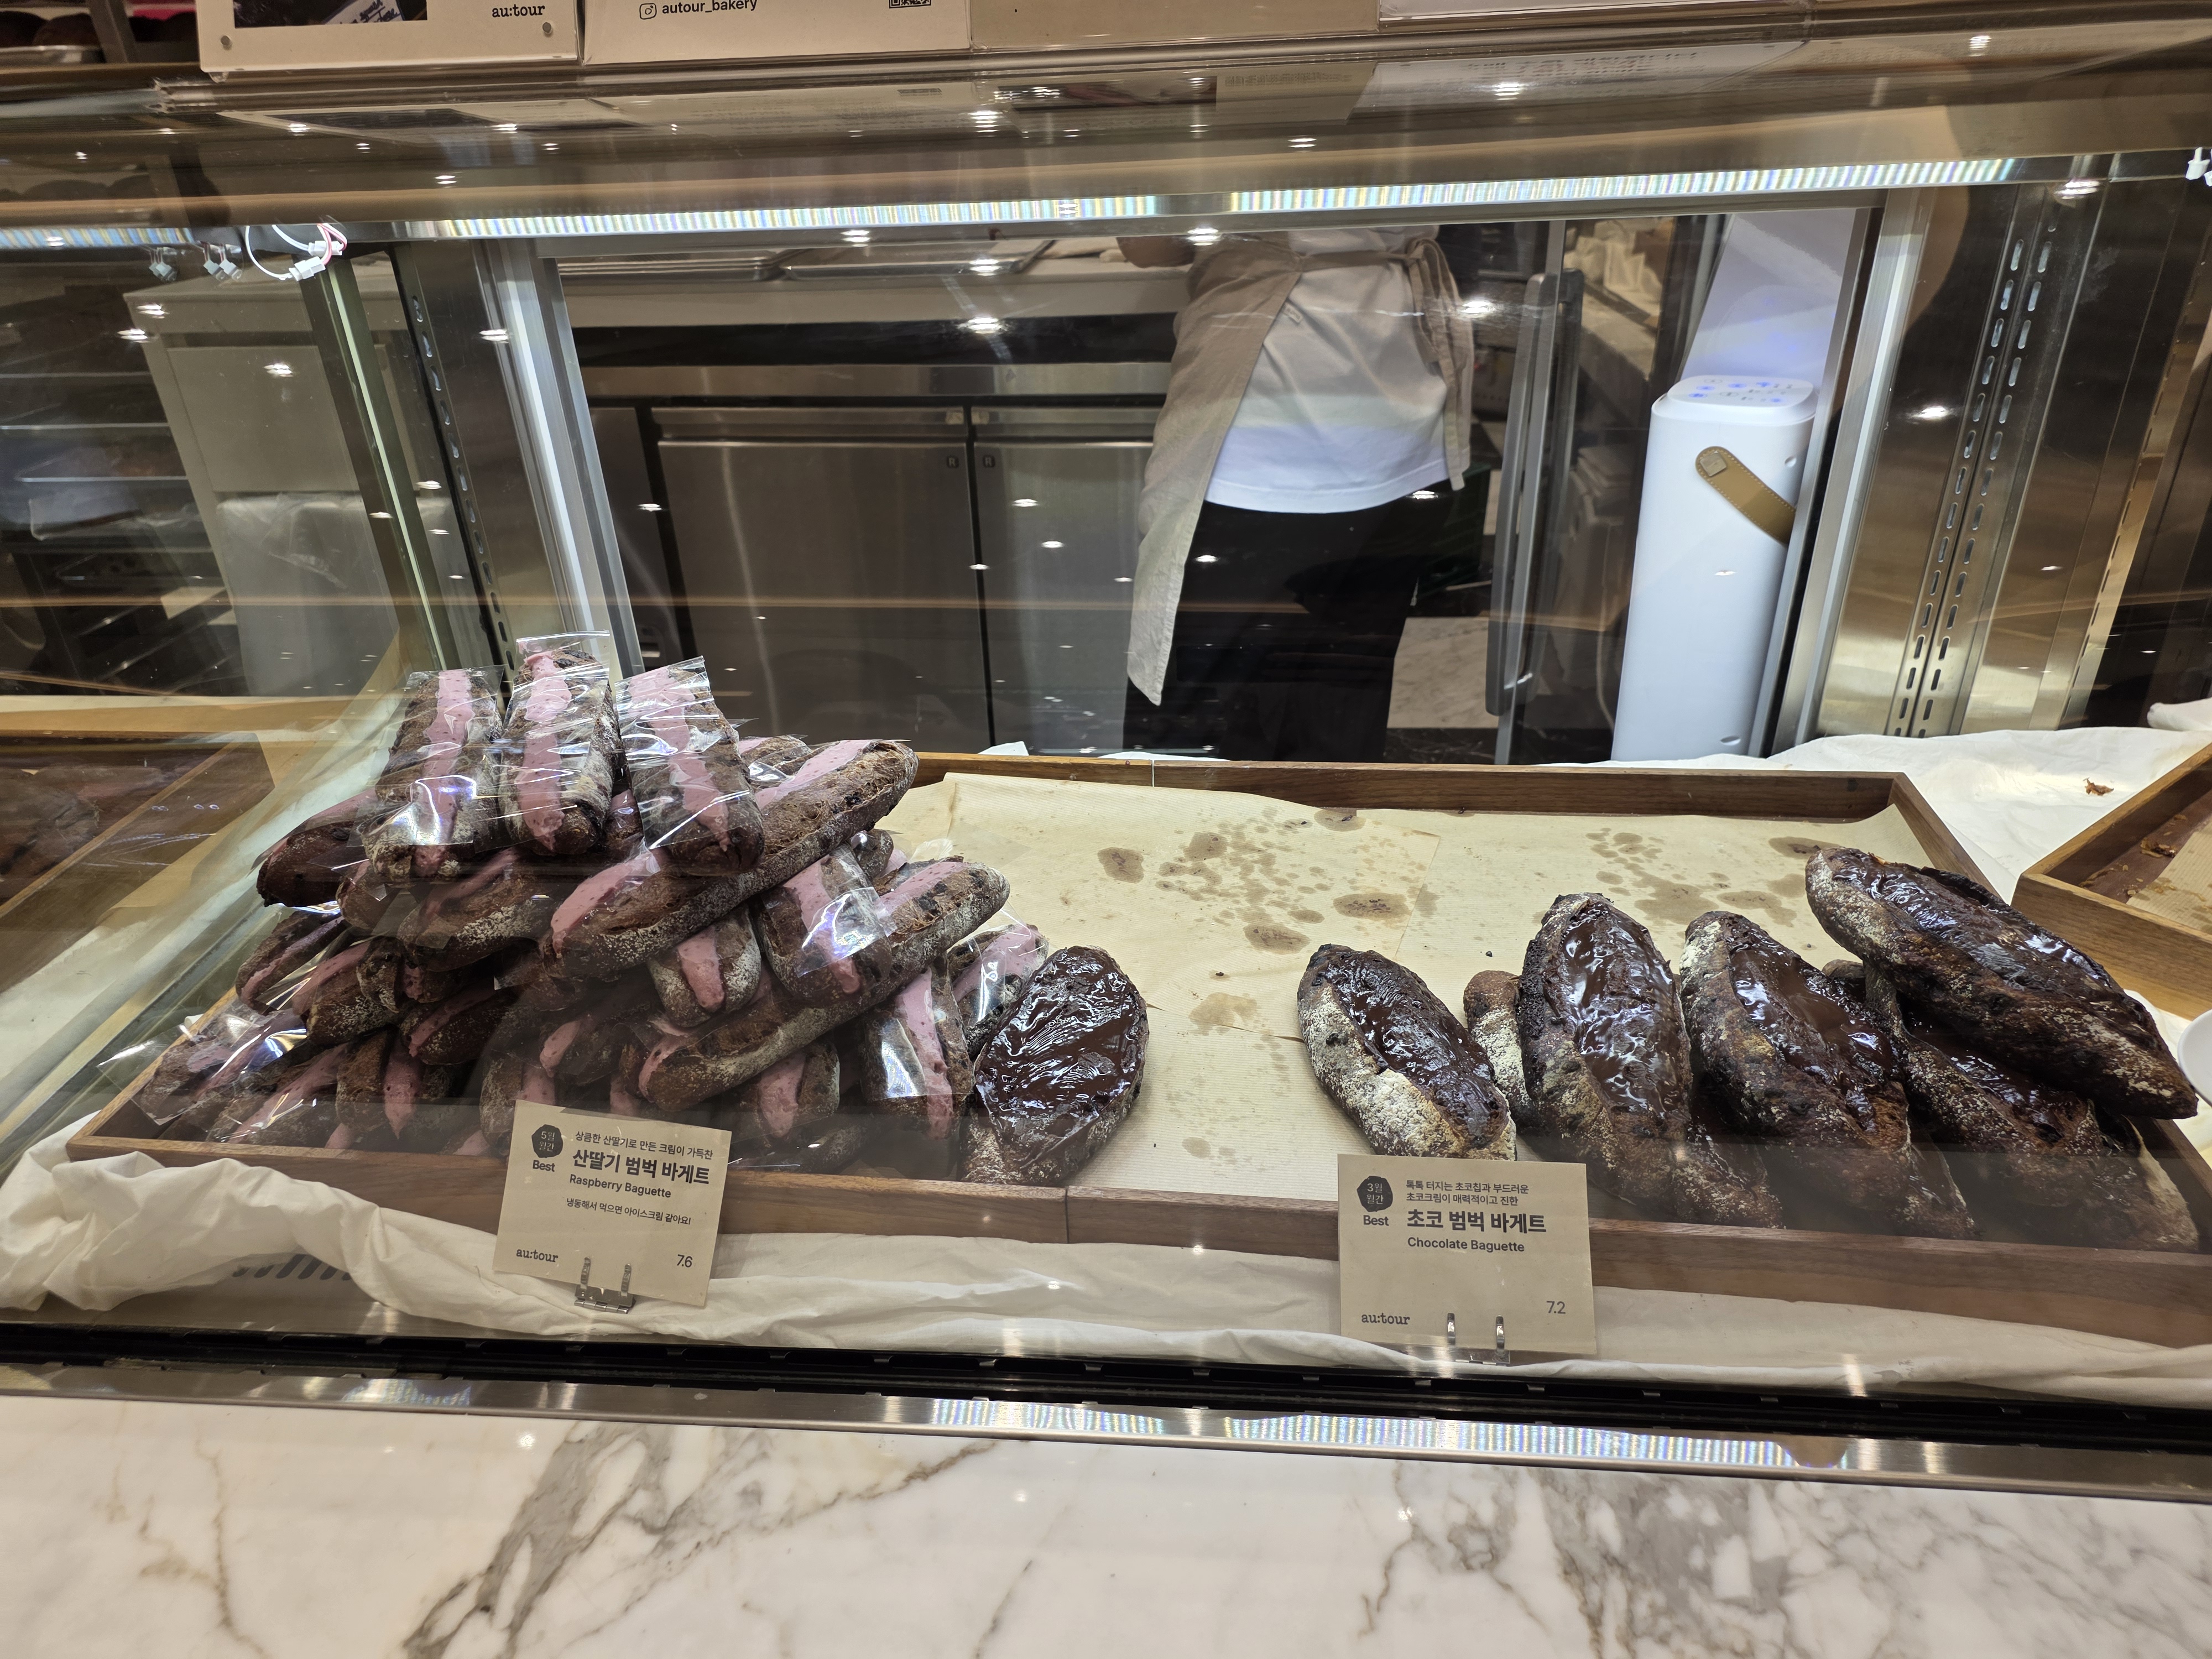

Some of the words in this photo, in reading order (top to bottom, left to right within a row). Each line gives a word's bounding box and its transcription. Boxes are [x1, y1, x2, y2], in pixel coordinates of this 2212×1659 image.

[492, 4, 545, 18] au:tour
[662, 0, 758, 14] autour_bakery
[541, 1131, 555, 1141] 5월
[539, 1141, 555, 1152] 월간
[575, 1131, 601, 1144] 상큼한
[603, 1135, 637, 1149] 산딸기로
[640, 1140, 657, 1152] 만든
[659, 1143, 685, 1156] 크림이
[687, 1147, 713, 1160] 가득찬
[533, 1160, 555, 1172] Best
[572, 1149, 621, 1173] 산딸기
[625, 1156, 658, 1178] 범벅
[661, 1162, 709, 1185] 바게트
[569, 1174, 623, 1192] Raspberry
[624, 1182, 671, 1198] Baguette
[1367, 1183, 1383, 1193] 3월
[1406, 1180, 1424, 1190] 톡톡
[1426, 1181, 1453, 1191] 터지는
[1455, 1182, 1491, 1193] 초코칩과
[1493, 1183, 1530, 1194] 부드러운
[1366, 1194, 1384, 1204] 월간
[1406, 1192, 1451, 1203] 초코크림이
[1453, 1194, 1498, 1205] 매력적이고
[1500, 1196, 1519, 1206] 진한
[566, 1198, 597, 1211] 냉동해서
[599, 1203, 623, 1215] 먹으면
[624, 1207, 664, 1221] 아이스크림
[665, 1213, 691, 1225] 같아요!
[1363, 1214, 1389, 1226] Best
[1407, 1209, 1444, 1228] 초코
[1449, 1211, 1485, 1232] 범벅
[1490, 1212, 1547, 1234] 바게트
[1407, 1237, 1468, 1249] Chocolate
[1470, 1239, 1525, 1253] Baguette
[516, 1249, 559, 1262] au:tour
[676, 1254, 693, 1268] 7.6
[1546, 1301, 1566, 1314] 7.2
[1361, 1312, 1410, 1326] au:tour
